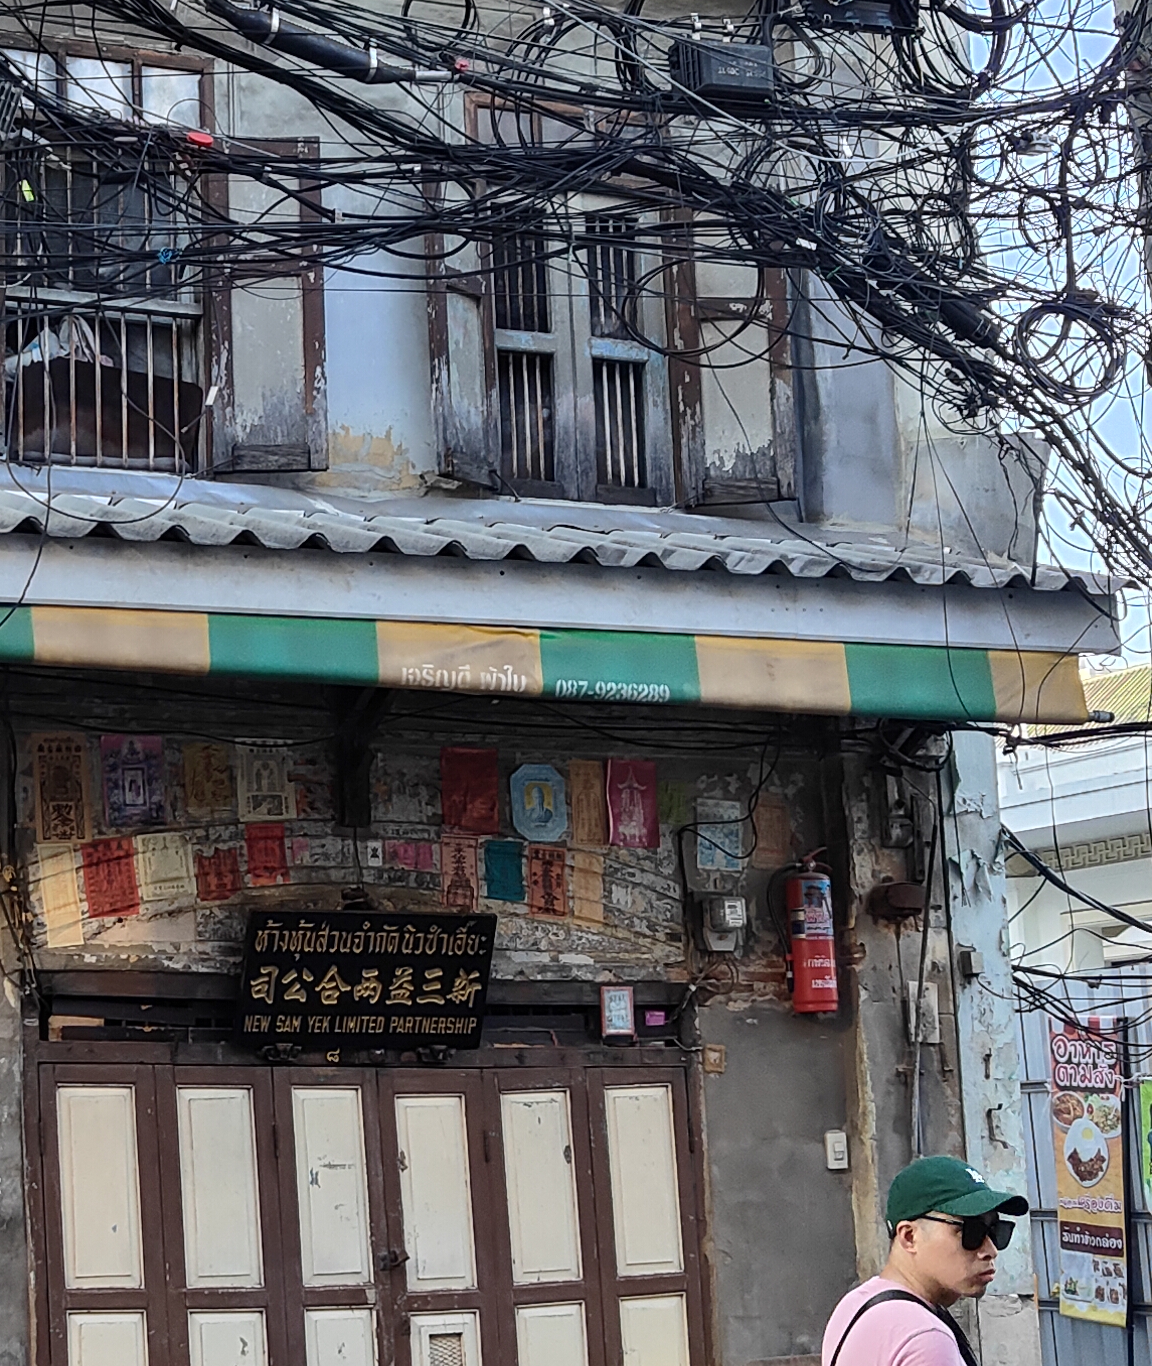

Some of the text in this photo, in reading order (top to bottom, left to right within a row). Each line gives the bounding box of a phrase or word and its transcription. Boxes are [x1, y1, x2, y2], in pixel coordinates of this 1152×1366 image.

[555, 679, 670, 703] 087-9236289
[244, 1015, 478, 1035] NEW SAM YEK LIMITED PARTNERSHIP
